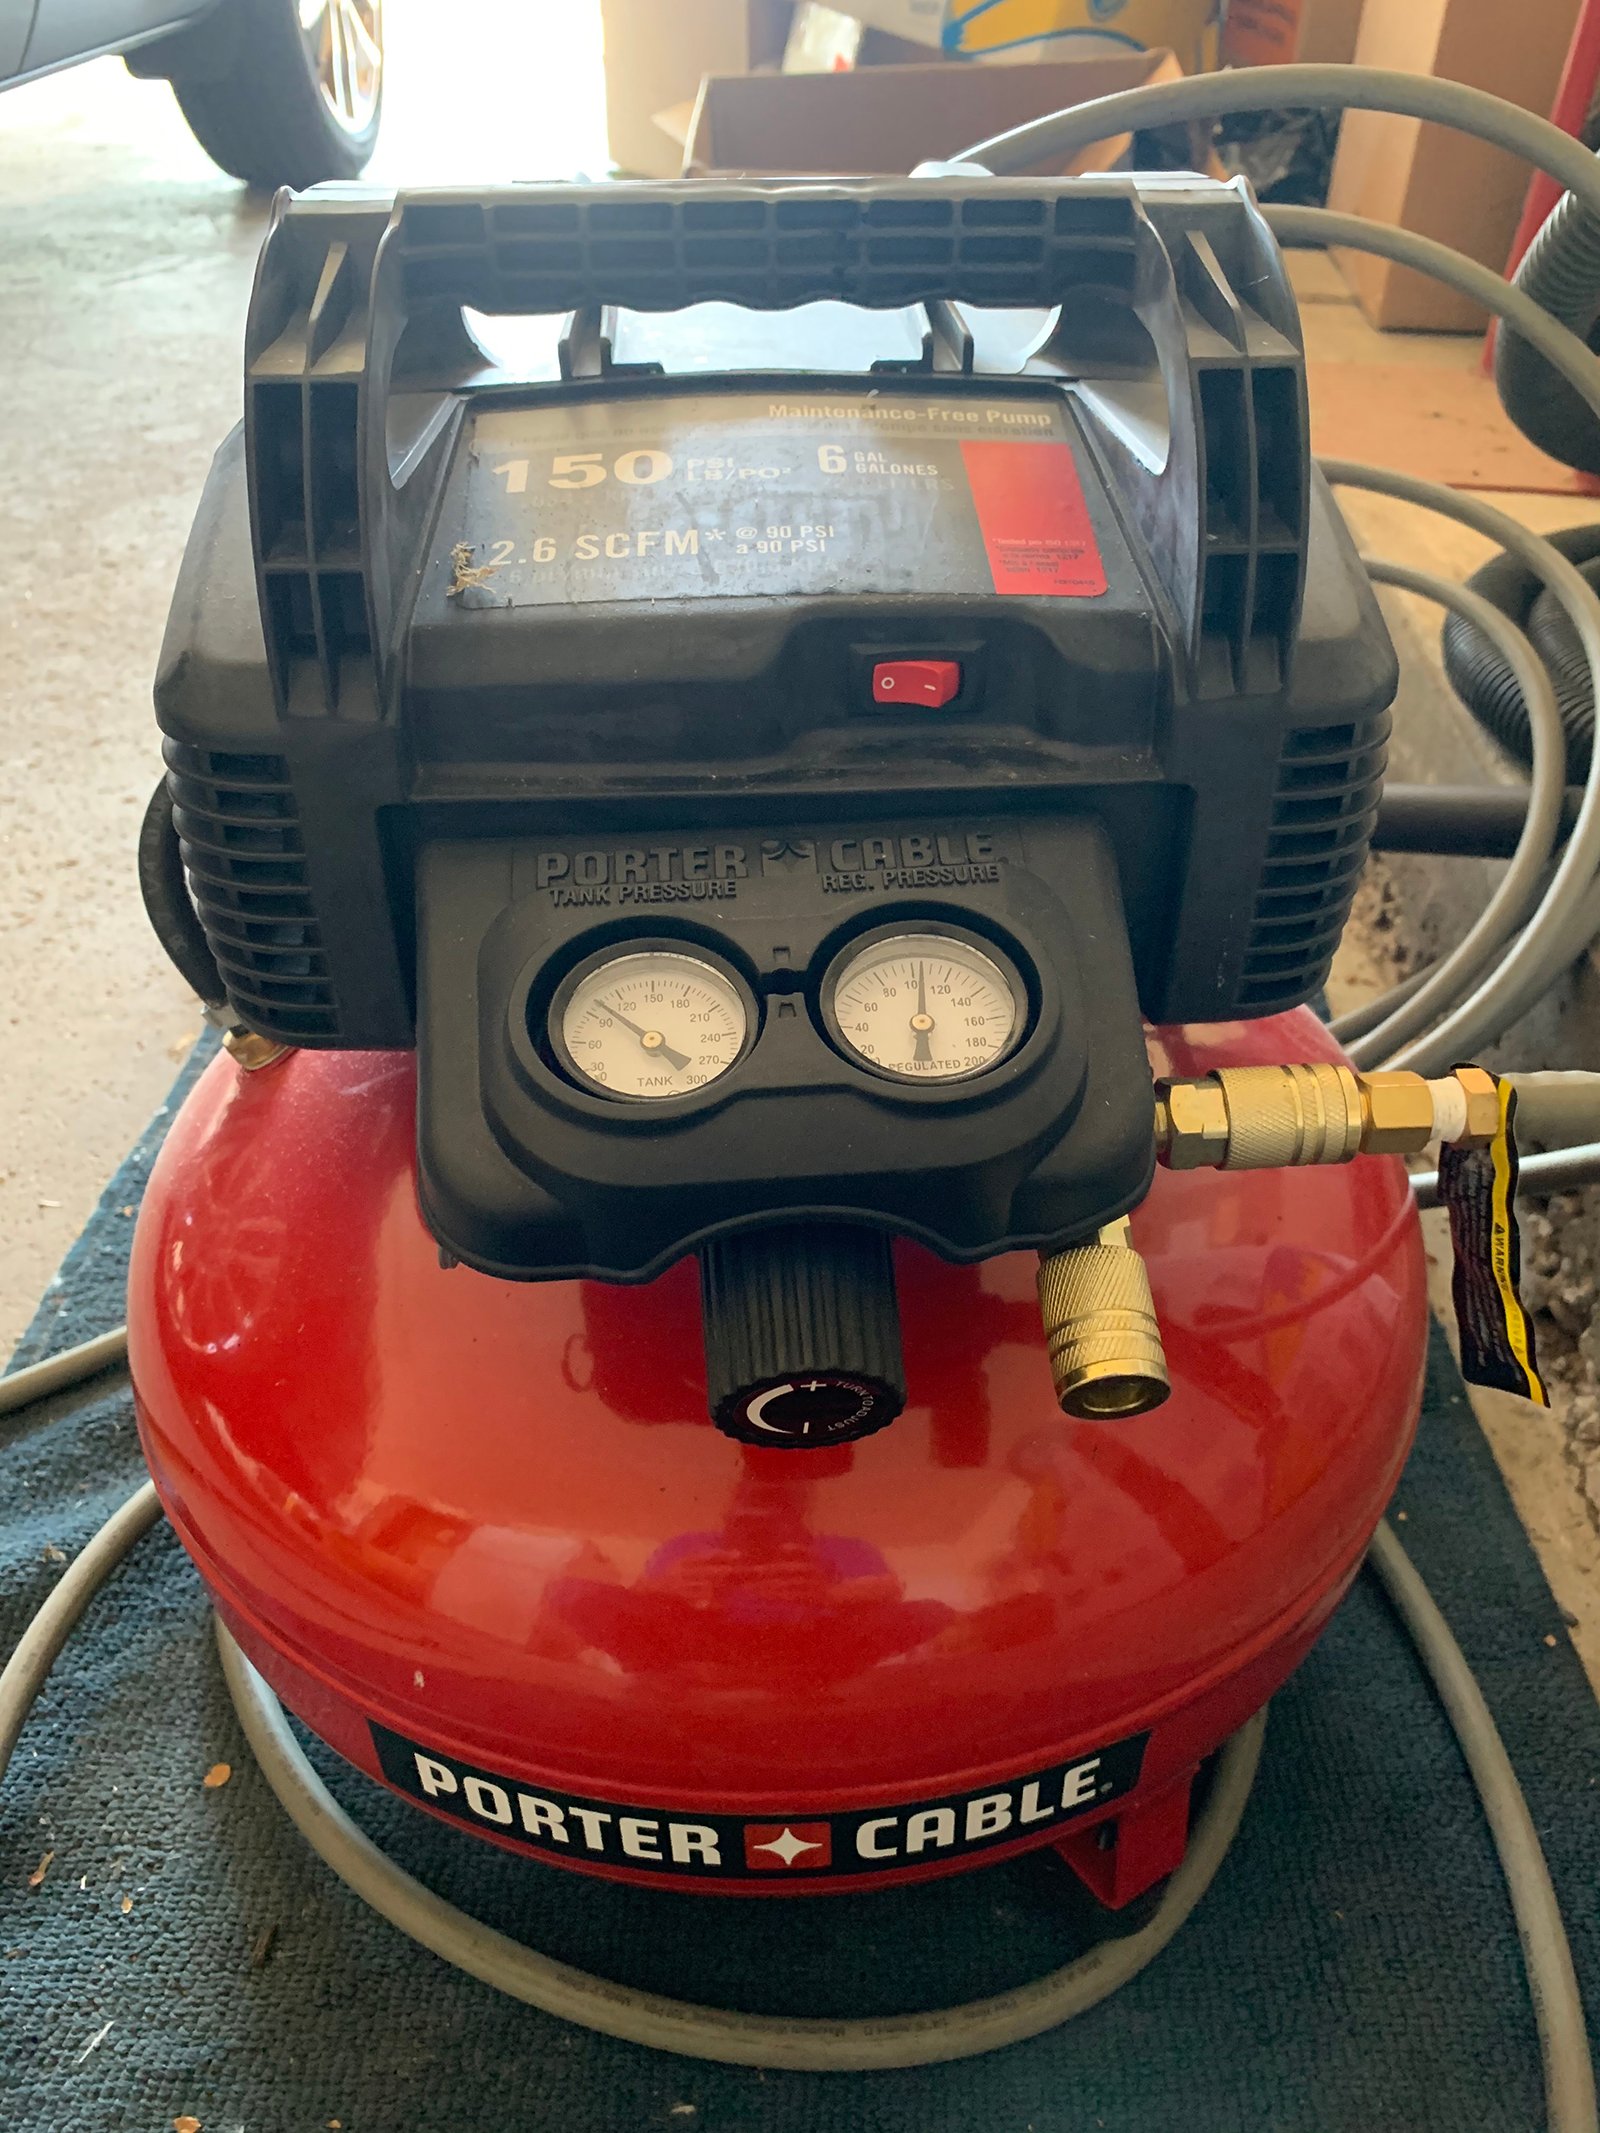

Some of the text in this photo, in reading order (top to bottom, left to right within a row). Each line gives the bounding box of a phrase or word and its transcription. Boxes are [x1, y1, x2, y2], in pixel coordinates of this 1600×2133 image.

[768, 404, 1052, 428] Maintenance-Free Pump
[686, 457, 735, 470] PSI
[817, 444, 848, 474] 6
[853, 451, 888, 464] GAL
[491, 449, 675, 493] 150
[855, 462, 939, 477] GALONES
[735, 524, 836, 540] @ 90 PSI
[488, 536, 558, 567] 2.6
[735, 538, 827, 555] a 90 PSI
[535, 832, 999, 889] PORTER CABLE
[821, 863, 1001, 893] REG. PRESSURE
[549, 878, 738, 908] TANK PRESSURE
[882, 987, 897, 998] 80
[930, 984, 951, 996] 120
[644, 993, 664, 1004] 150
[670, 999, 690, 1009] 180
[950, 997, 972, 1008] 140
[617, 1002, 637, 1012] 120
[864, 1002, 878, 1013] 60
[599, 1017, 613, 1028] 90
[689, 1012, 710, 1023] 210
[964, 1016, 985, 1028] 160
[854, 1022, 869, 1032] 40
[700, 1033, 721, 1043] 240
[965, 1036, 987, 1048] 180
[588, 1039, 602, 1050] 60
[860, 1044, 875, 1056] 20
[591, 1061, 605, 1072] 30
[698, 1055, 720, 1066] 270
[888, 1060, 961, 1073] REGULATED
[963, 1055, 986, 1068] 200
[636, 1075, 673, 1088] TANK
[686, 1074, 708, 1086] 300
[835, 1381, 870, 1397] TURN
[827, 1406, 871, 1431] ADJUST
[413, 1750, 1101, 1867] PORTER CABLE
